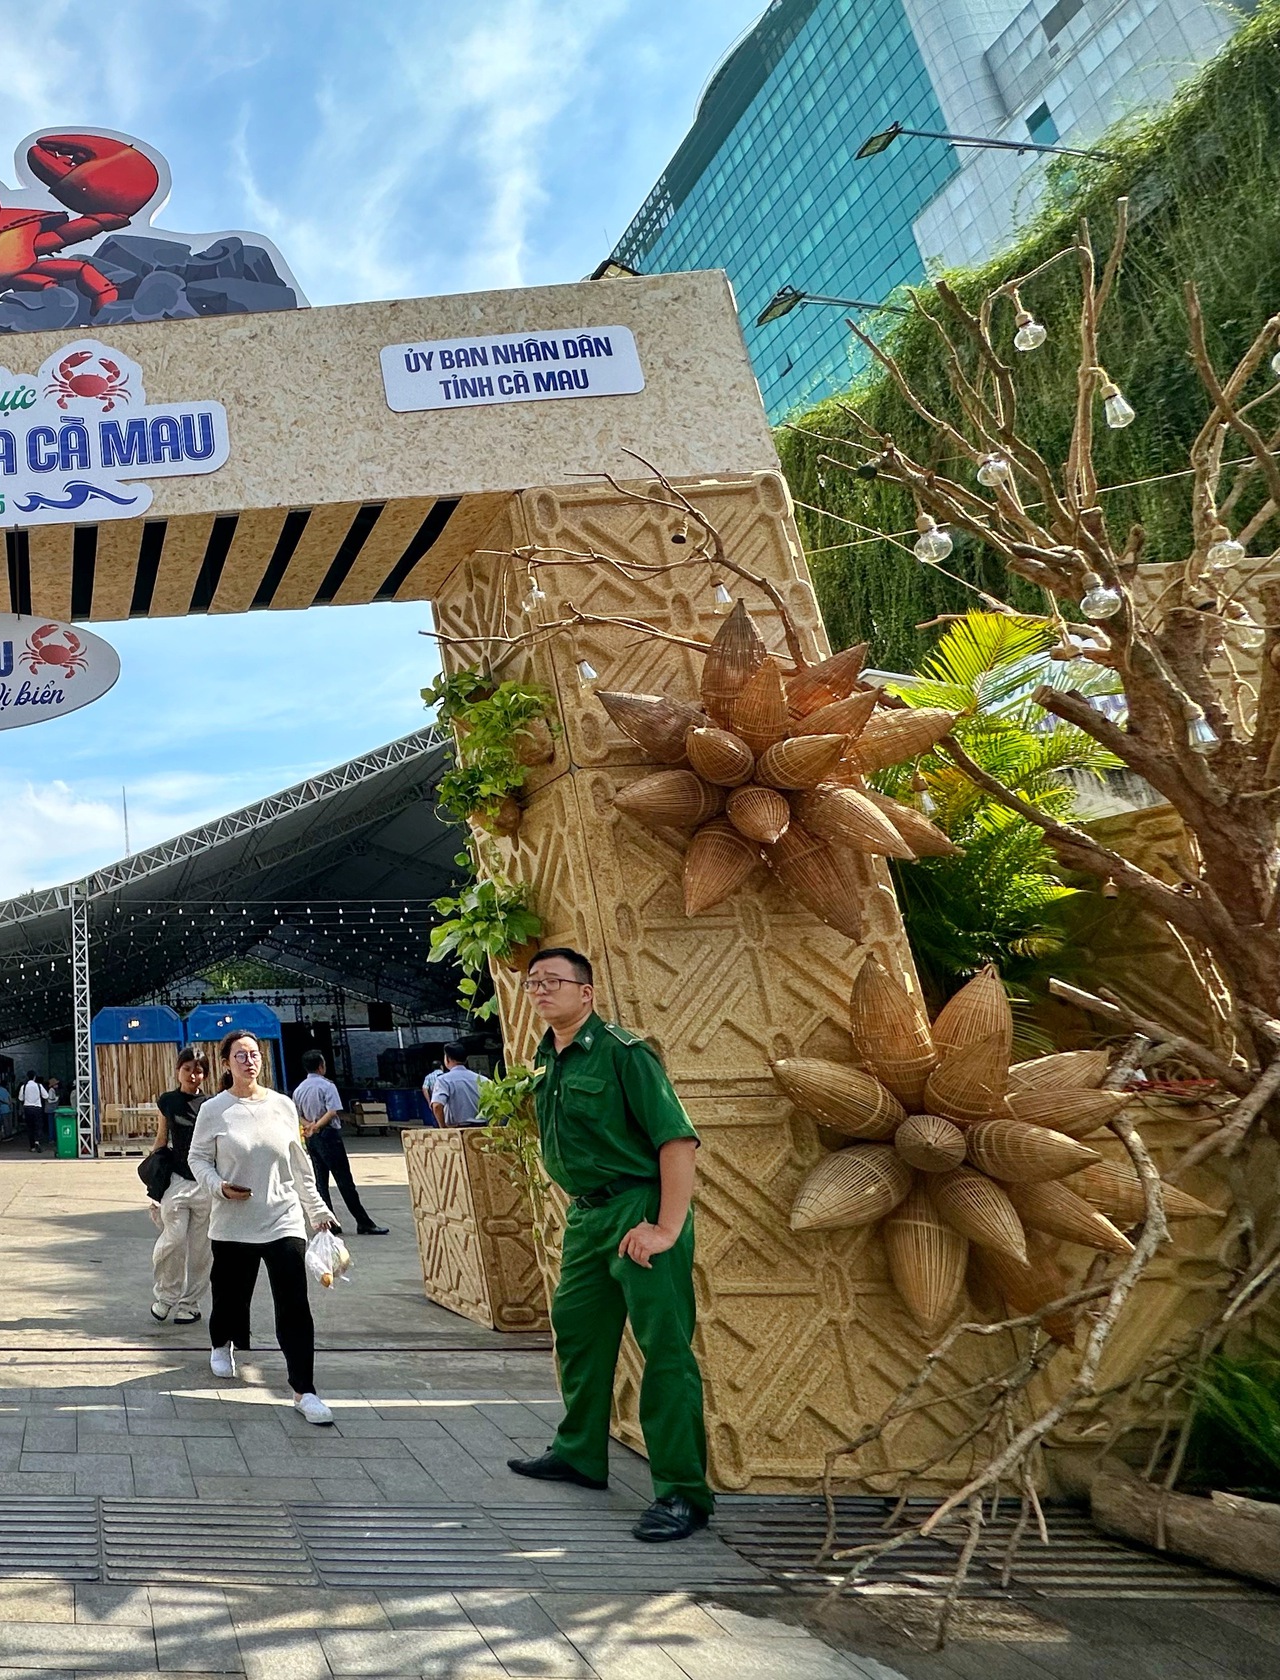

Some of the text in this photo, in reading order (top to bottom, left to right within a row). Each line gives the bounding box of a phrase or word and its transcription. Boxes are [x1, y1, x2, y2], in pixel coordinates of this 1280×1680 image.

[404, 334, 613, 373] ỦY BAN NHÂN DÂN
[439, 368, 589, 400] TỈNH CÀ MAU
[26, 416, 91, 473] CÀ
[99, 412, 216, 469] MAU
[14, 680, 65, 706] biển
